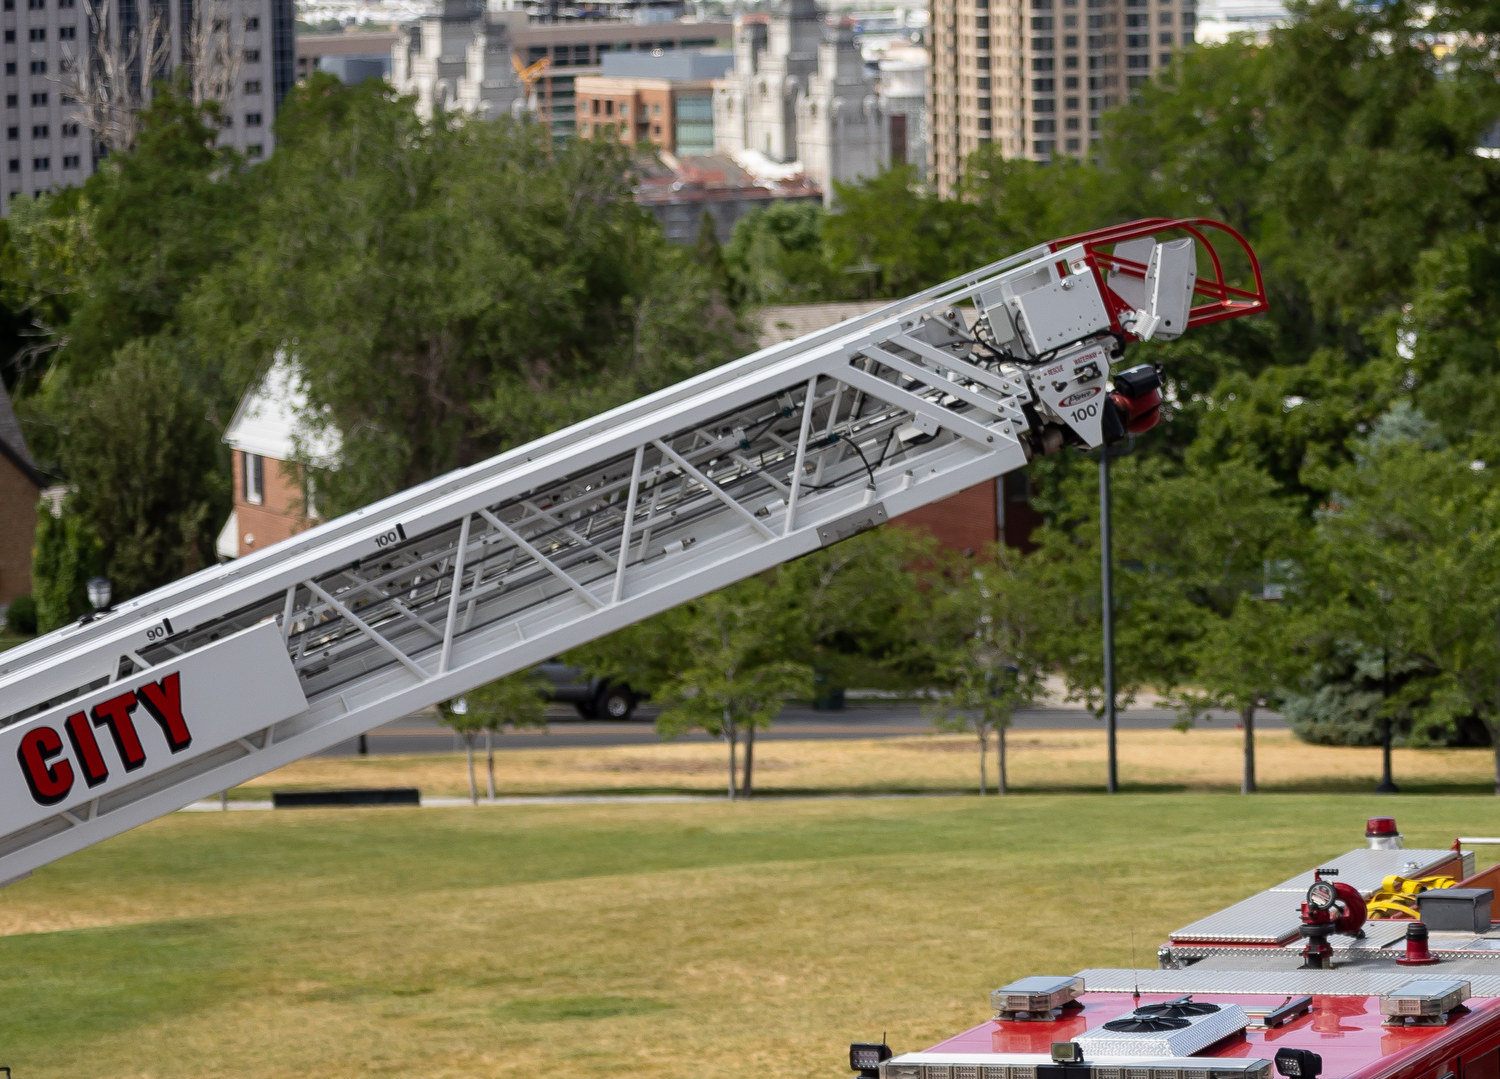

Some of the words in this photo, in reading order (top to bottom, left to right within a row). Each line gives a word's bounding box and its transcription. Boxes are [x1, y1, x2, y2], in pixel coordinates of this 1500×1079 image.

[375, 531, 397, 548] 100
[146, 626, 164, 641] 90
[17, 671, 192, 806] CITY
